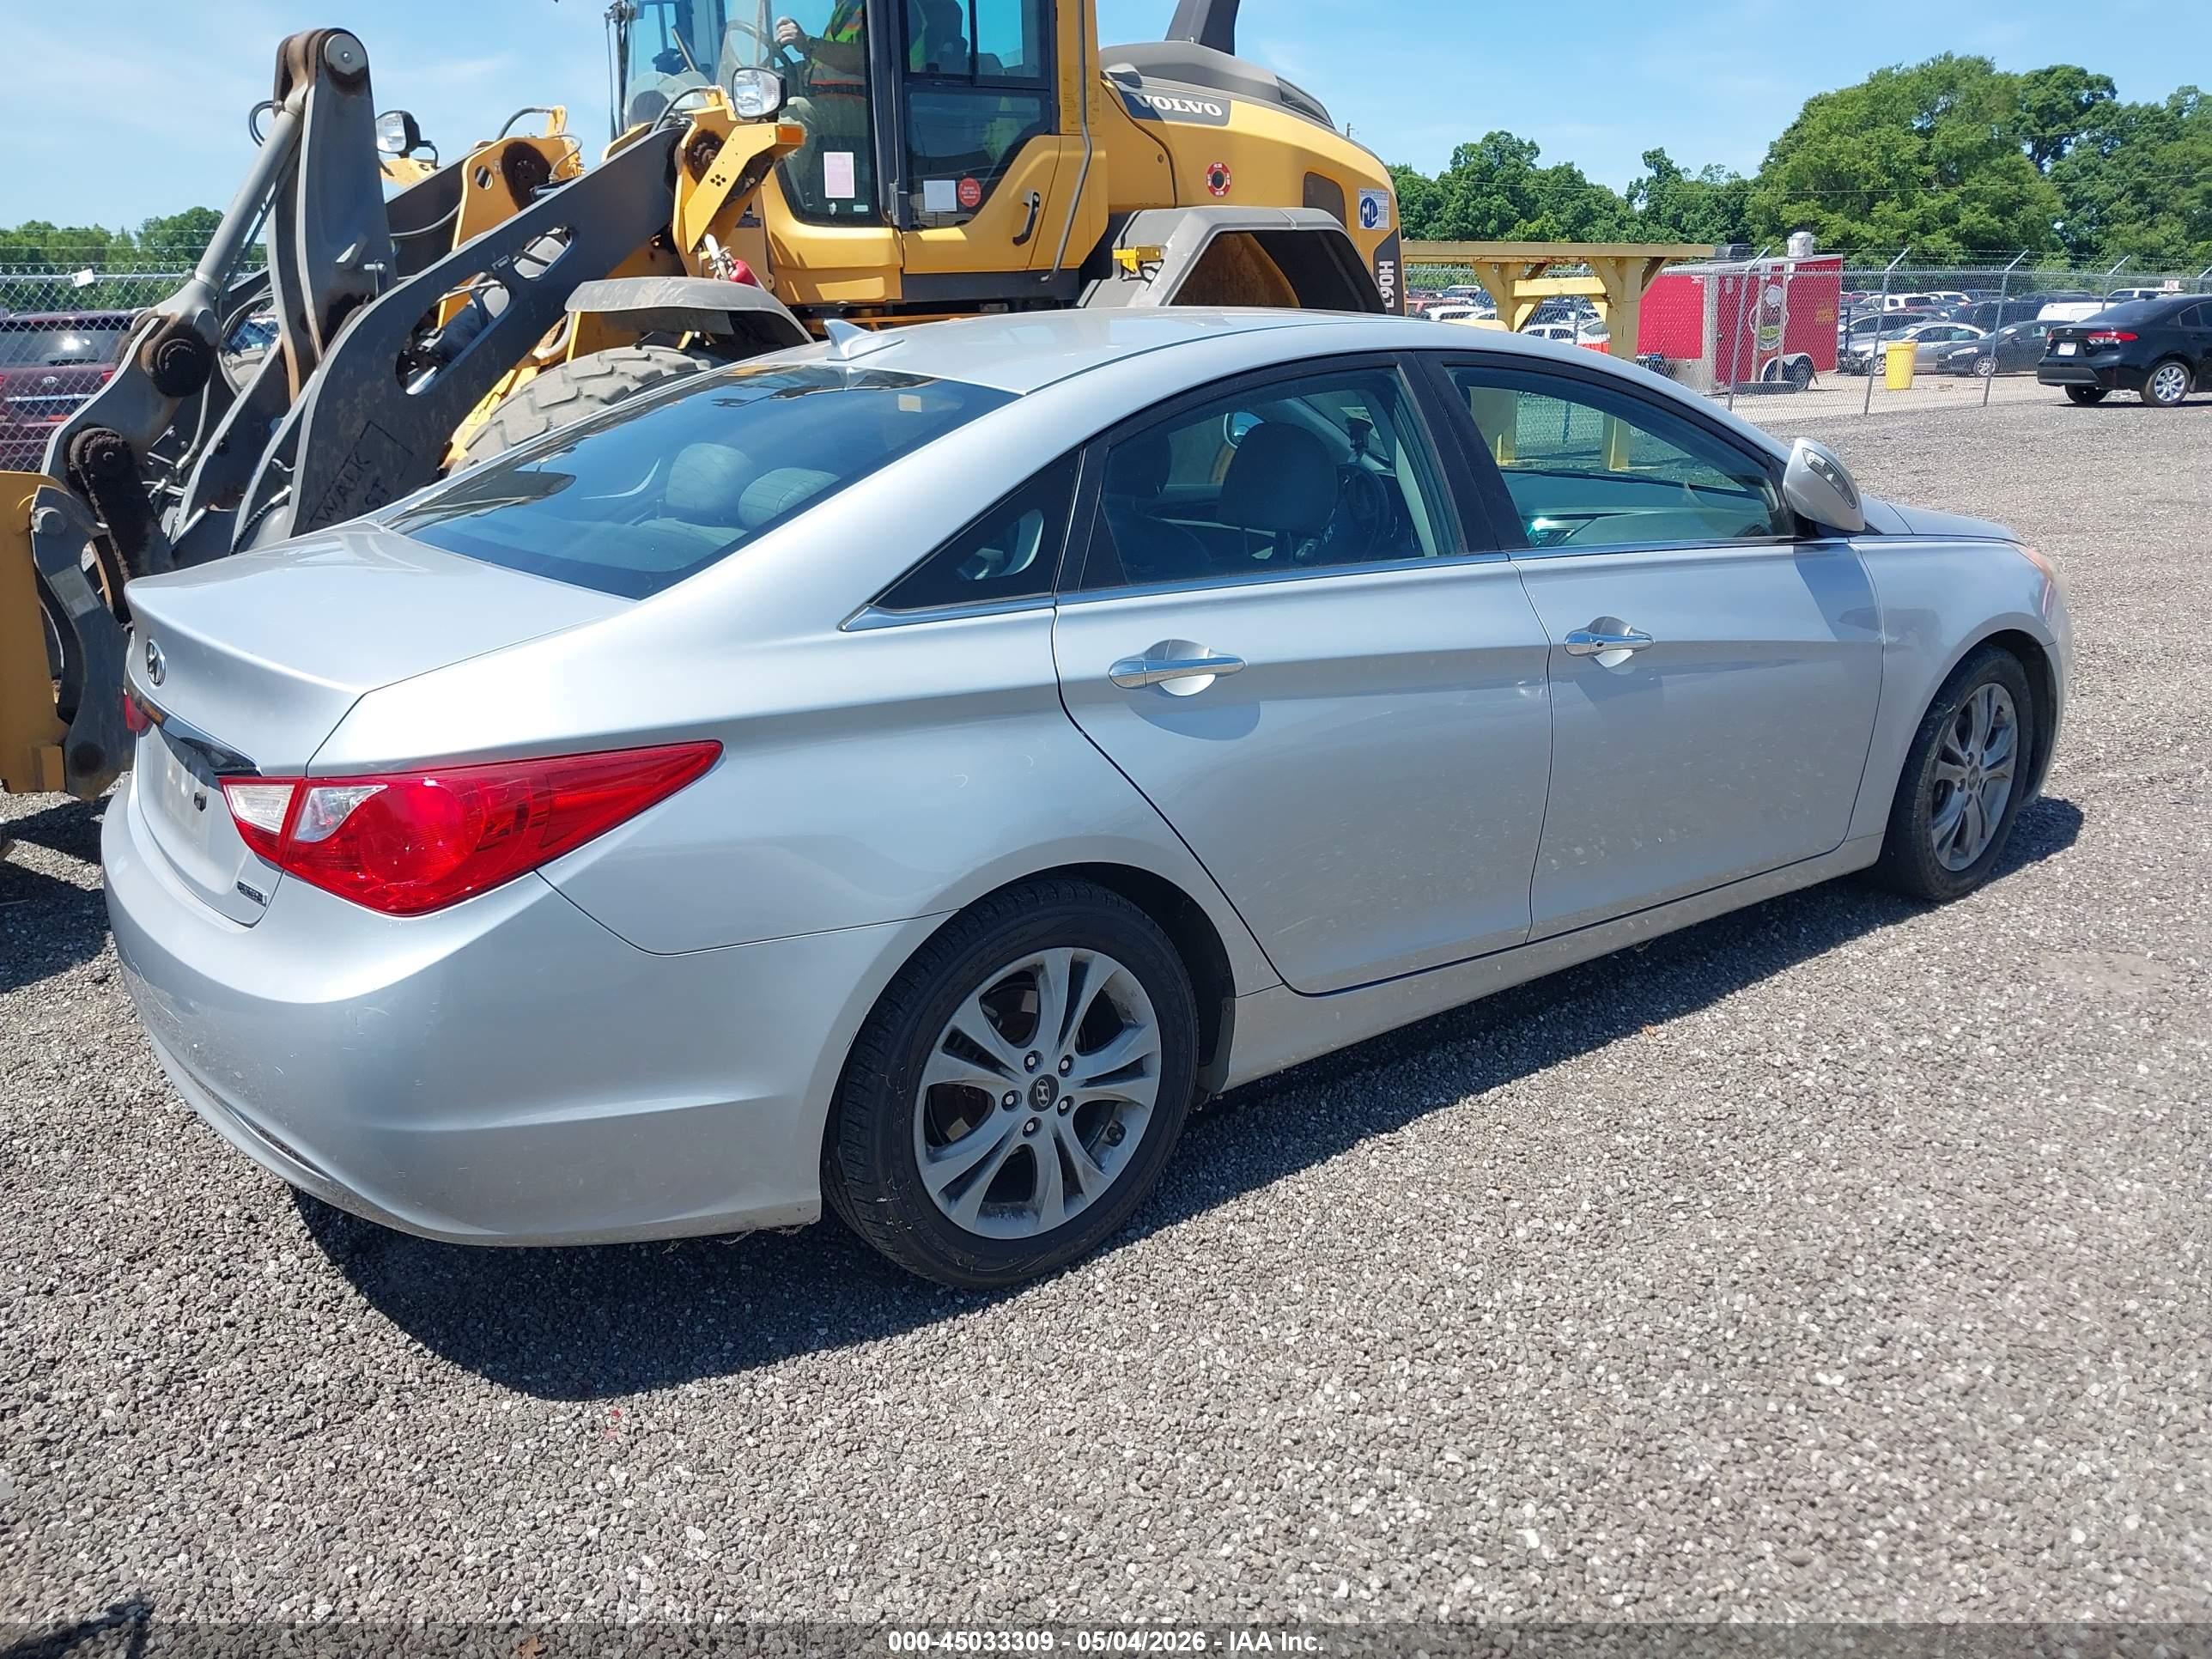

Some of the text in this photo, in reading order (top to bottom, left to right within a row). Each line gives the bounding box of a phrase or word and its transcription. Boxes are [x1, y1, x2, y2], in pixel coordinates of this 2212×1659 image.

[1129, 94, 1223, 118] VOLVO
[1361, 201, 1379, 224] ML
[1378, 261, 1395, 309] L90H
